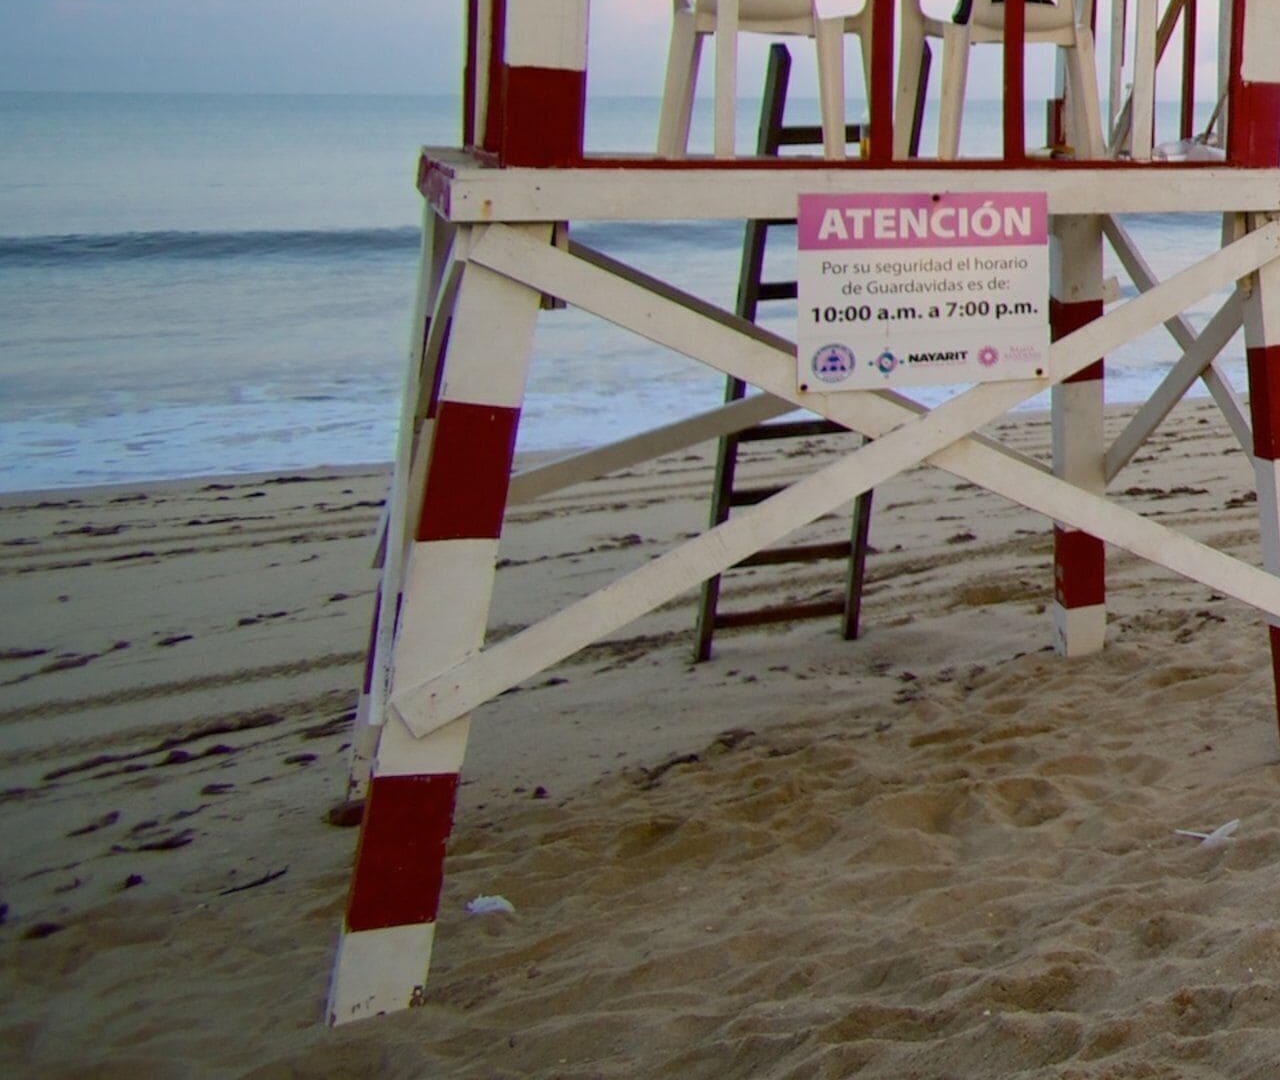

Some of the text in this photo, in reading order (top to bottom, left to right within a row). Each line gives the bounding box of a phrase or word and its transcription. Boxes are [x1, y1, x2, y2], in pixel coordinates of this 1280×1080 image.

[817, 201, 1032, 241] ATENCIÓN
[822, 256, 1028, 276] Por su seguridad el horario
[841, 277, 1010, 295] de Guardavidas es de:
[811, 301, 1038, 323] 10:00 a.m. a 7:00 p.m.
[908, 350, 969, 363] NAYARIT
